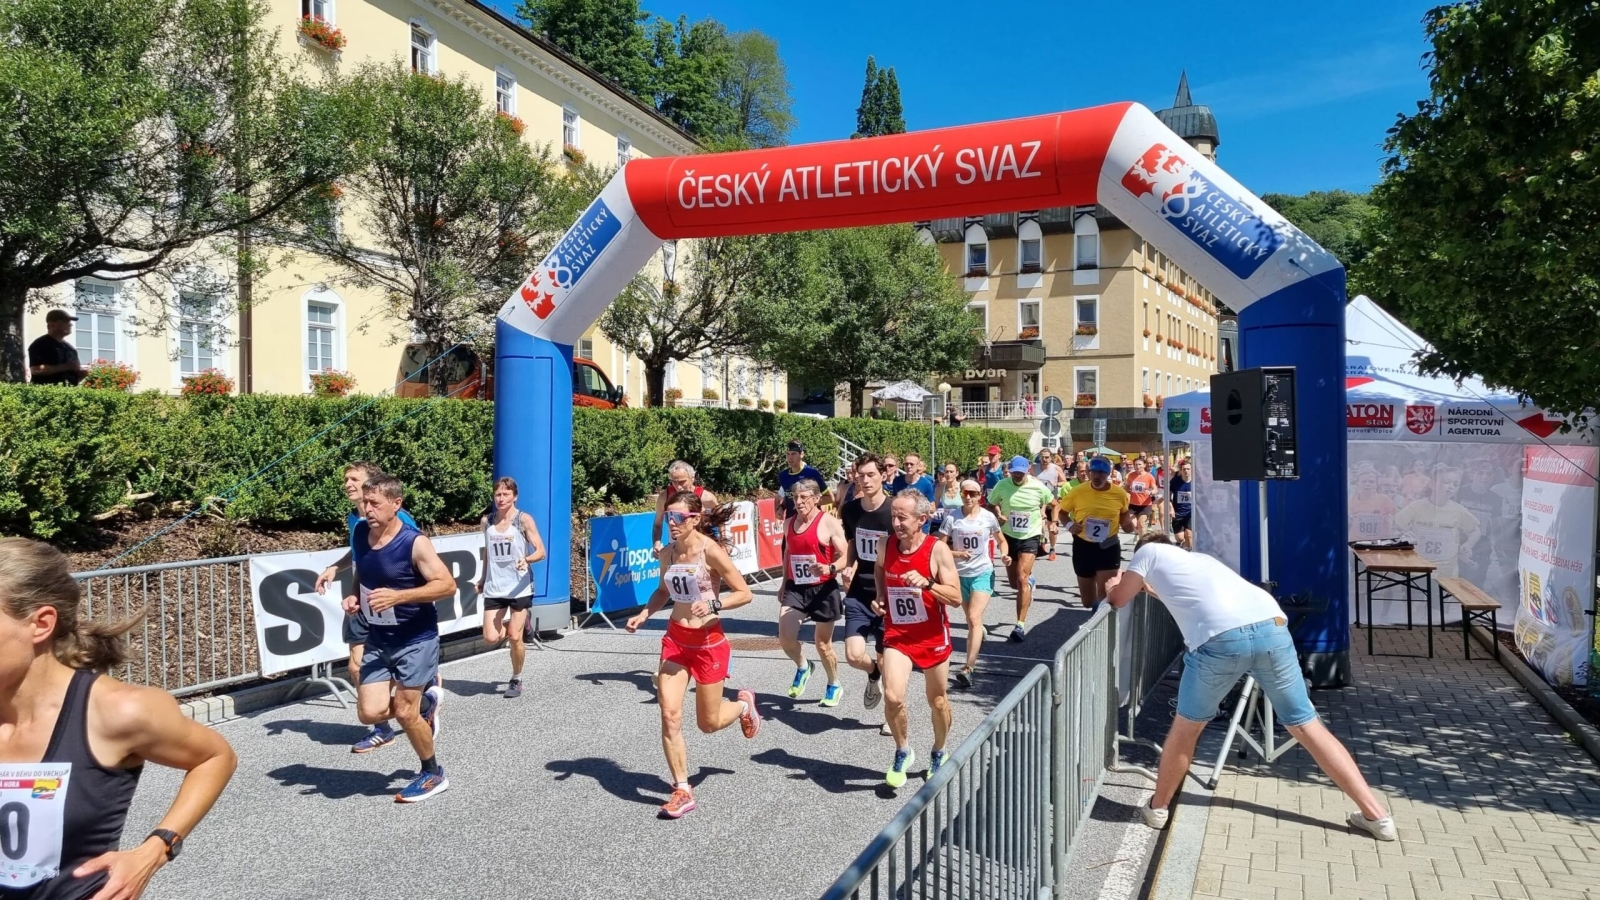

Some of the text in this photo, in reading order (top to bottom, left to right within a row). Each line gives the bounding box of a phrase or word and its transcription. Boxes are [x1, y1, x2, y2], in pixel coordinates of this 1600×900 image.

[678, 140, 1042, 210] ČESKÝ ATLETICKÝ SVAZ
[1205, 190, 1250, 226] ČESKÝ
[1182, 216, 1219, 248] SVAZ
[1192, 204, 1268, 261] ATLETICKÝ
[571, 244, 596, 273] SVAZ
[1346, 405, 1393, 418] ATON
[1448, 408, 1493, 416] NÁRODNÍ
[1366, 418, 1390, 426] stav
[1447, 417, 1504, 426] SPORTOVNÍ
[1447, 428, 1501, 436] AGENTURA
[1012, 517, 1029, 528] 122
[1092, 526, 1101, 537] 2
[493, 542, 511, 556] 117
[963, 537, 979, 549] 90
[619, 547, 660, 571] Tipspo
[642, 570, 647, 580] s
[672, 576, 689, 595] 81
[895, 598, 917, 616] 69
